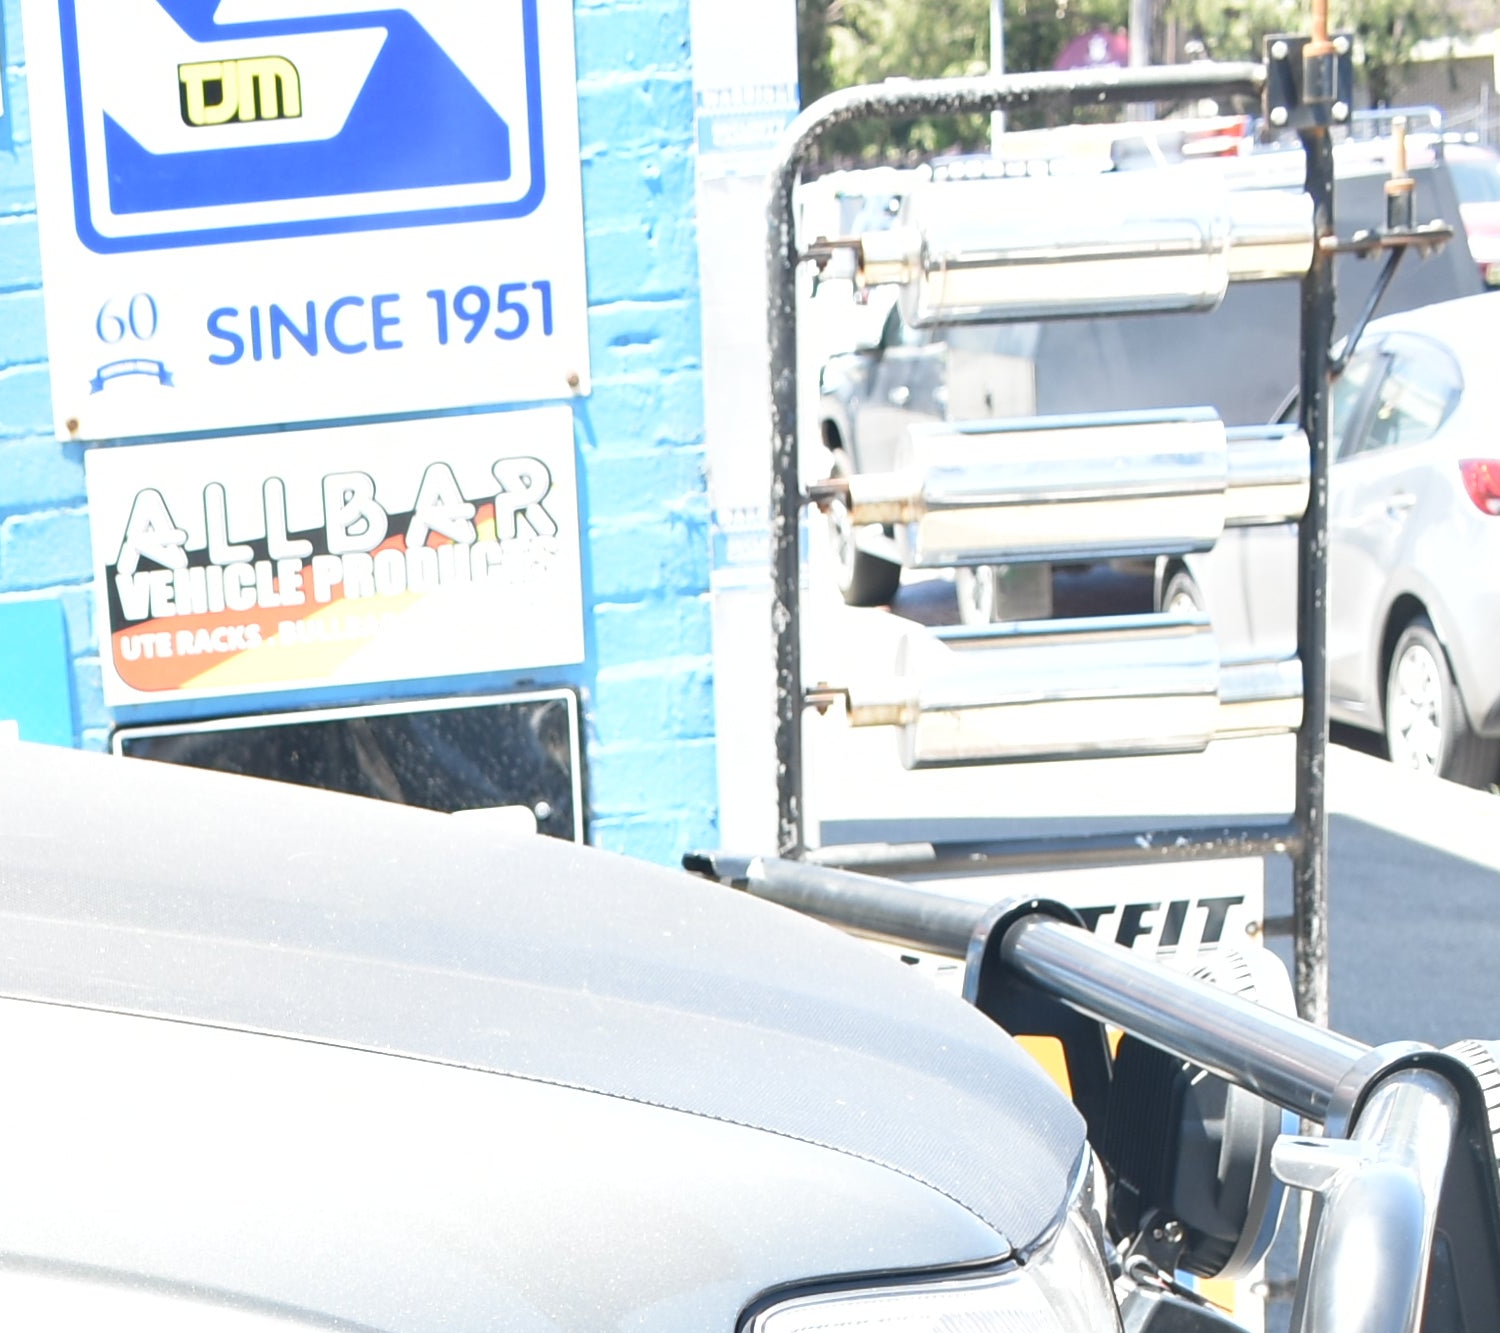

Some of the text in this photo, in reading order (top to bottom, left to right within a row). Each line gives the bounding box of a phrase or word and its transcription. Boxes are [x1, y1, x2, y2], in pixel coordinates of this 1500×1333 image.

[179, 56, 302, 127] TJM
[95, 292, 159, 344] 60
[206, 279, 555, 366] SINCE 1951
[116, 456, 561, 577] ALLBAR
[115, 557, 307, 621] VEHICLE
[119, 631, 174, 662] UTE
[175, 622, 263, 656] RACKS
